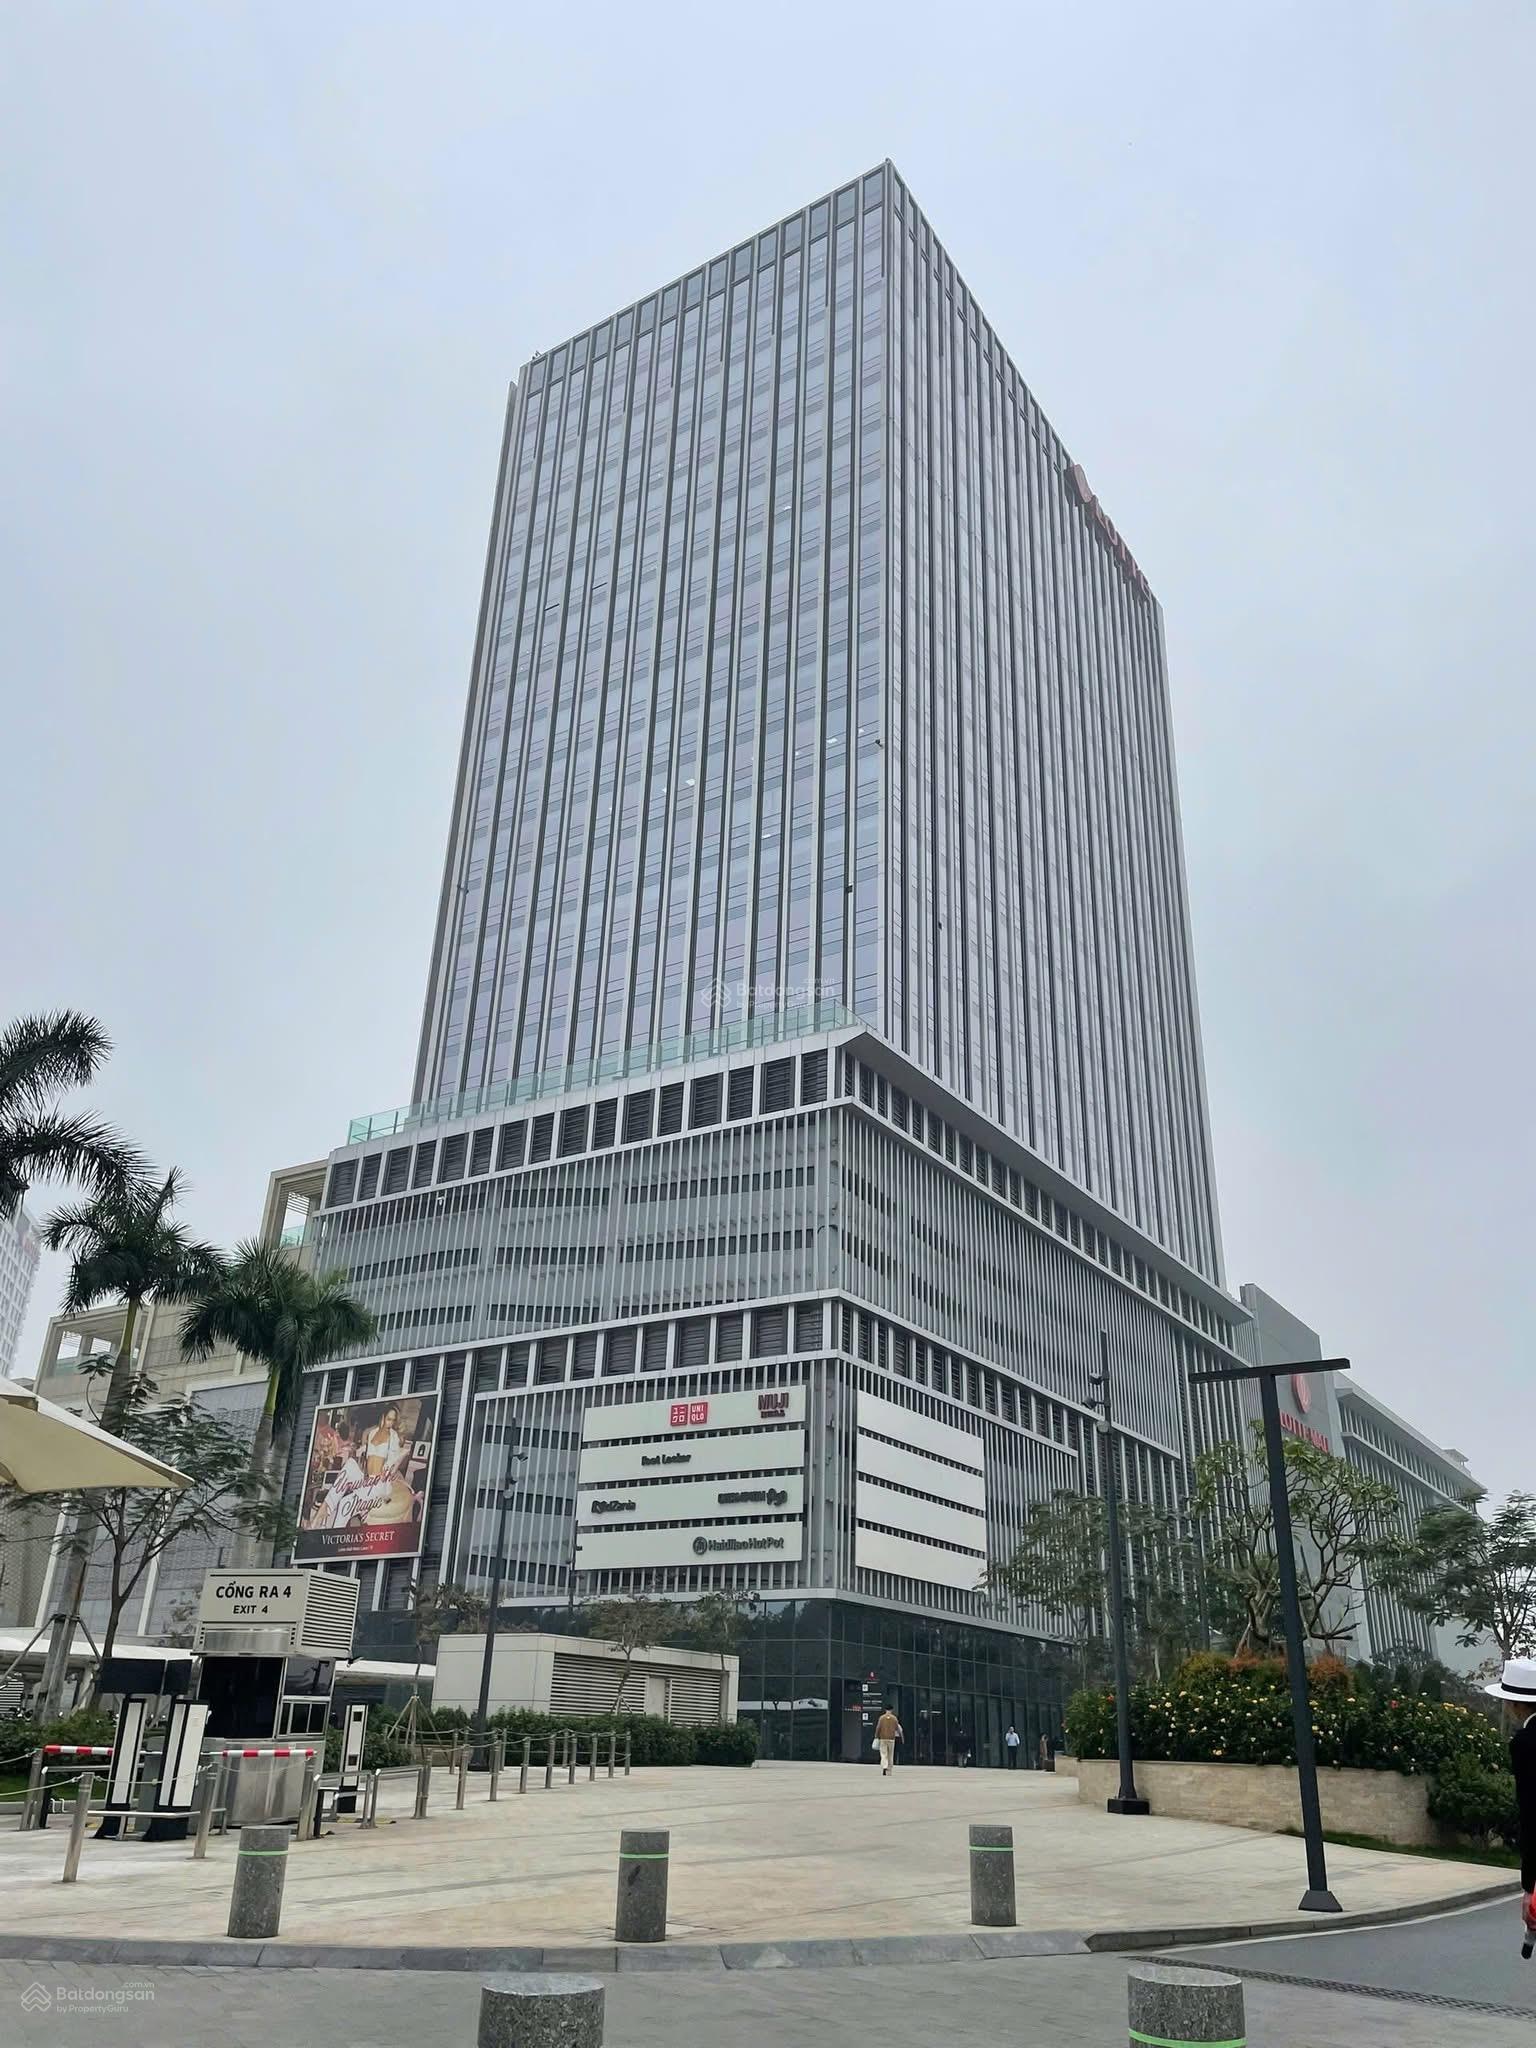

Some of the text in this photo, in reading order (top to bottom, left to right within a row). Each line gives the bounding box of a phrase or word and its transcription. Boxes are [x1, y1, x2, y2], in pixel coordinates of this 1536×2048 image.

[758, 1392, 789, 1410] MUJI
[691, 1405, 705, 1413] UNI
[691, 1414, 705, 1422] QLO
[322, 1531, 395, 1545] VICTORIA'S SECRET
[259, 1586, 279, 1598] RA
[283, 1586, 292, 1598] 4
[233, 1605, 269, 1614] EXIT 4
